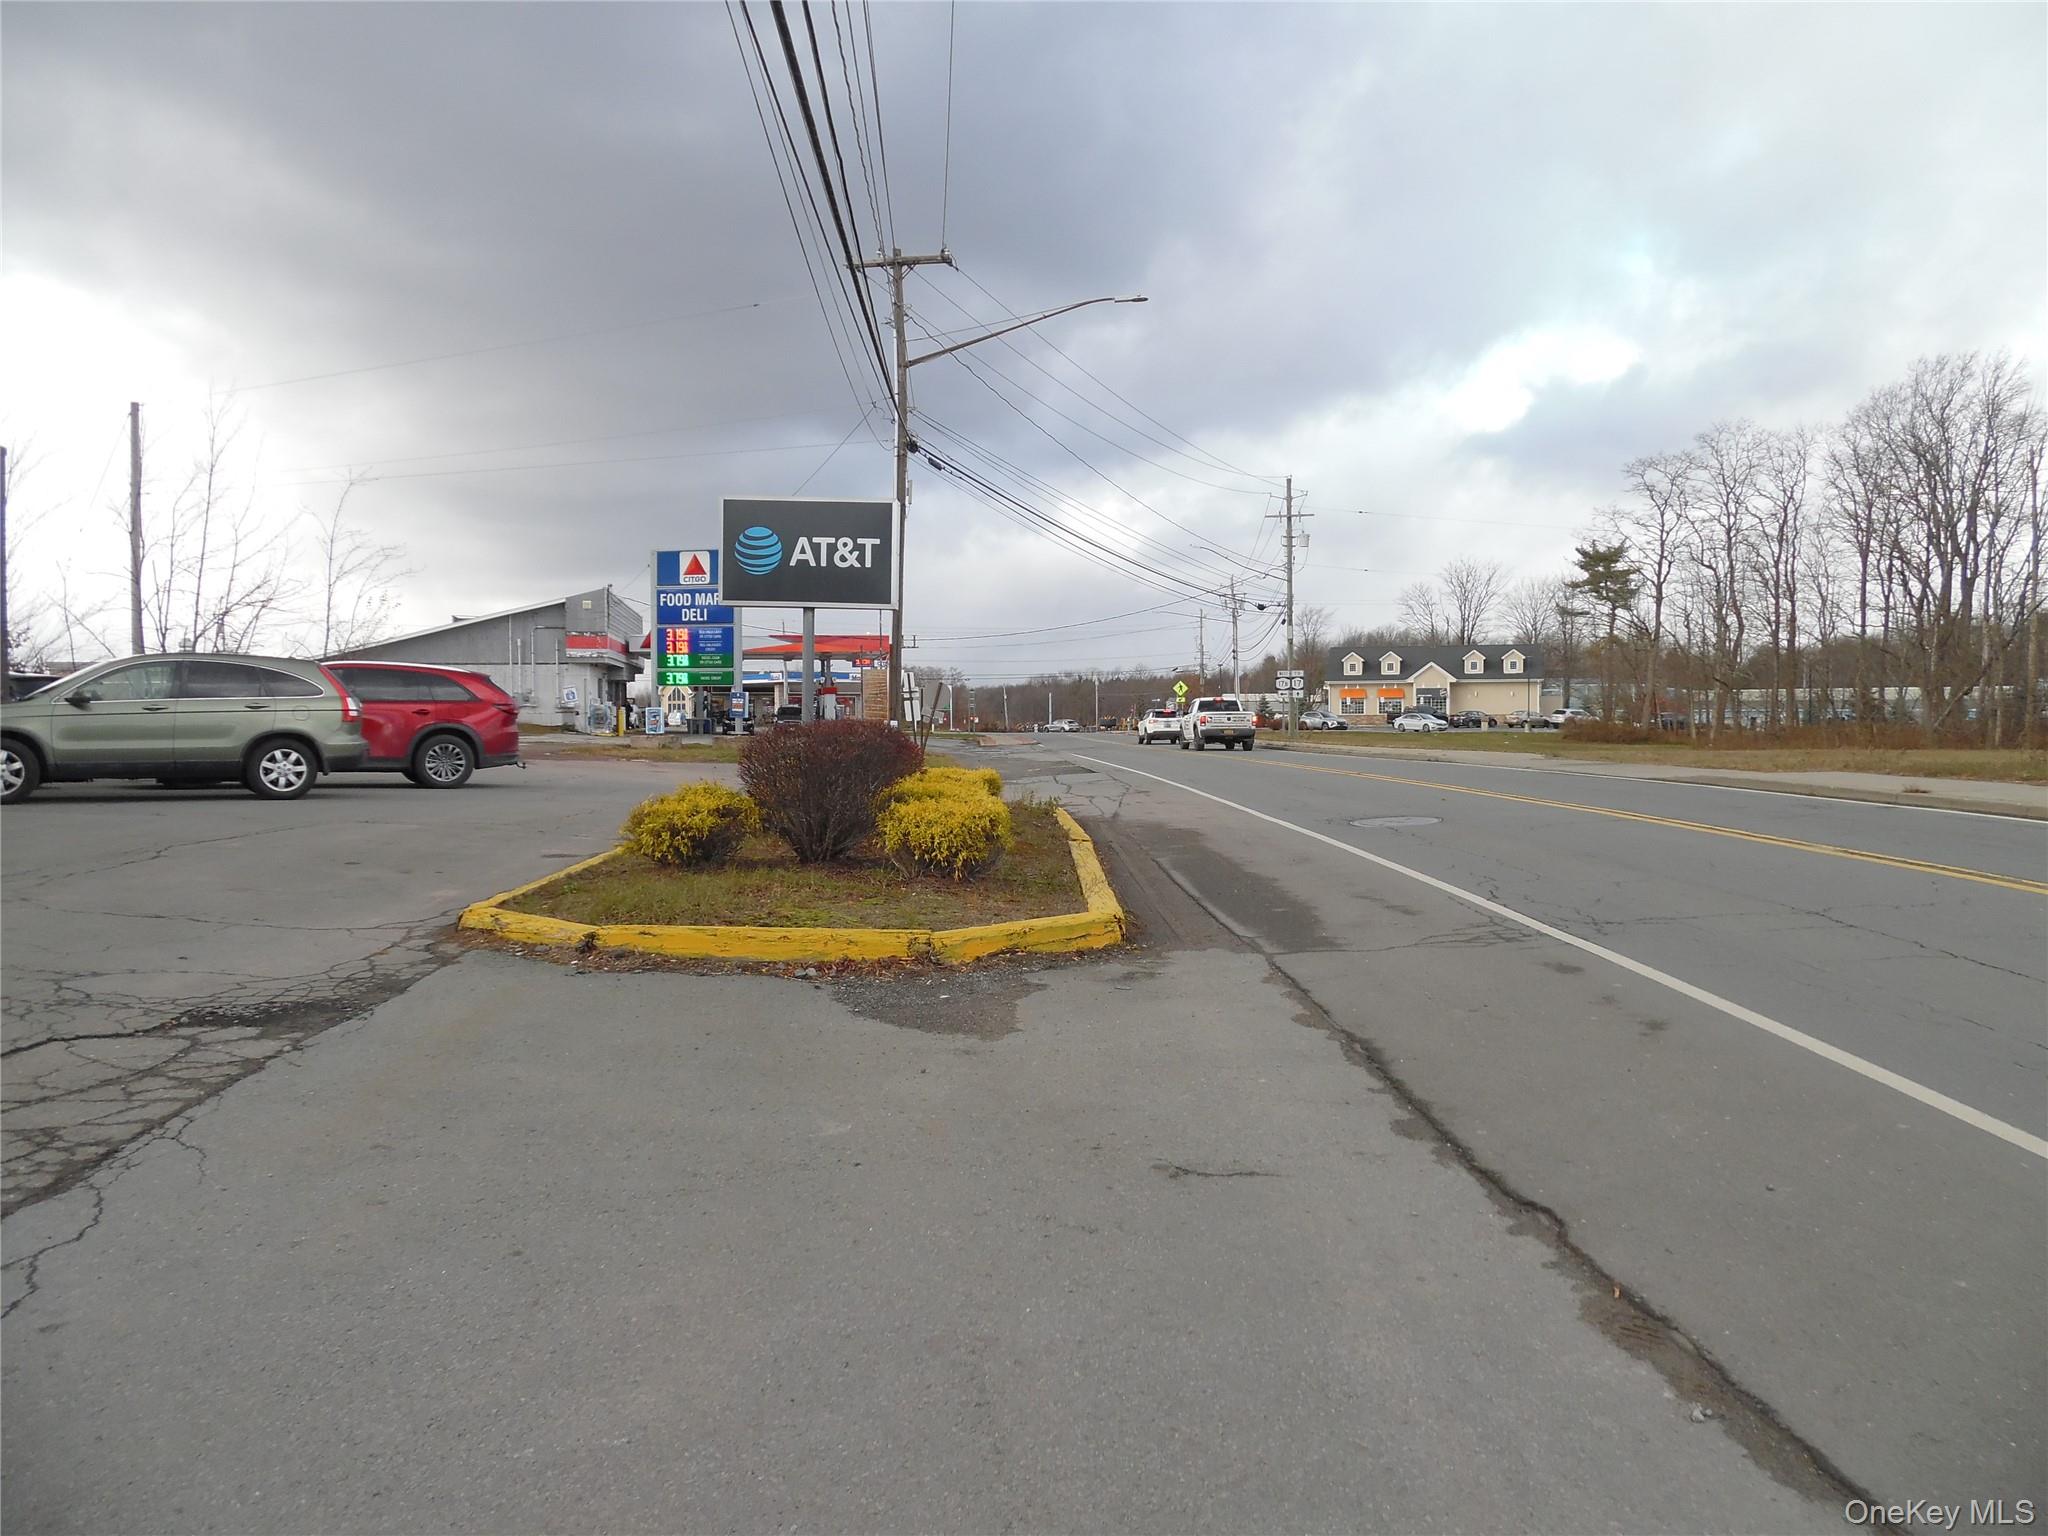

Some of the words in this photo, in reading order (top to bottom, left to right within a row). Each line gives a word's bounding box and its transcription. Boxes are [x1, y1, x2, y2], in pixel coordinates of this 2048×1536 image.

[789, 536, 881, 568] AT&T
[660, 593, 691, 606] FOOD
[681, 608, 707, 621] DELI
[1293, 679, 1302, 687] 17
